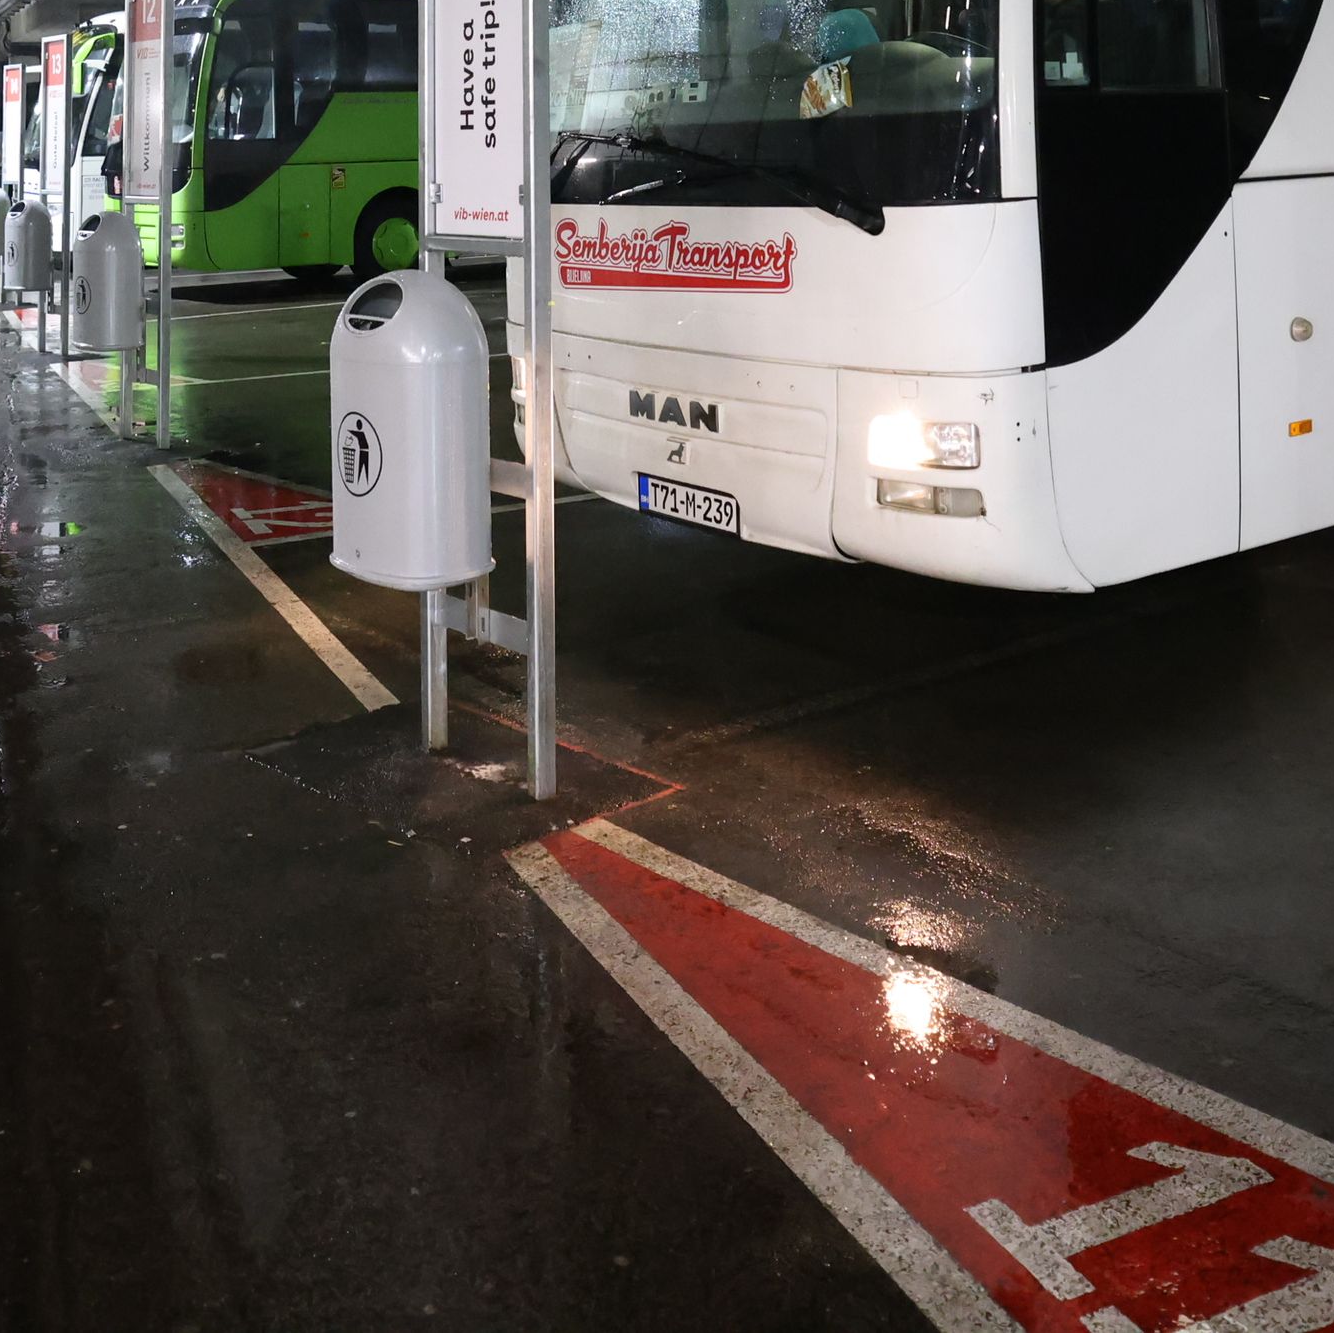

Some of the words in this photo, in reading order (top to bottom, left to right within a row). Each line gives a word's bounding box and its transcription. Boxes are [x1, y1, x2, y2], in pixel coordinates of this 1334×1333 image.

[463, 19, 474, 41] a
[480, 0, 499, 70] trip!
[51, 54, 62, 75] 13
[460, 49, 474, 130] Have
[142, 71, 151, 172] Willkommen!
[481, 77, 496, 148] safe
[453, 207, 509, 222] vib-wien.at
[556, 220, 661, 272] Semberija
[653, 224, 795, 281] Transport
[629, 389, 720, 433] MAN
[651, 482, 734, 527] T71-M-239
